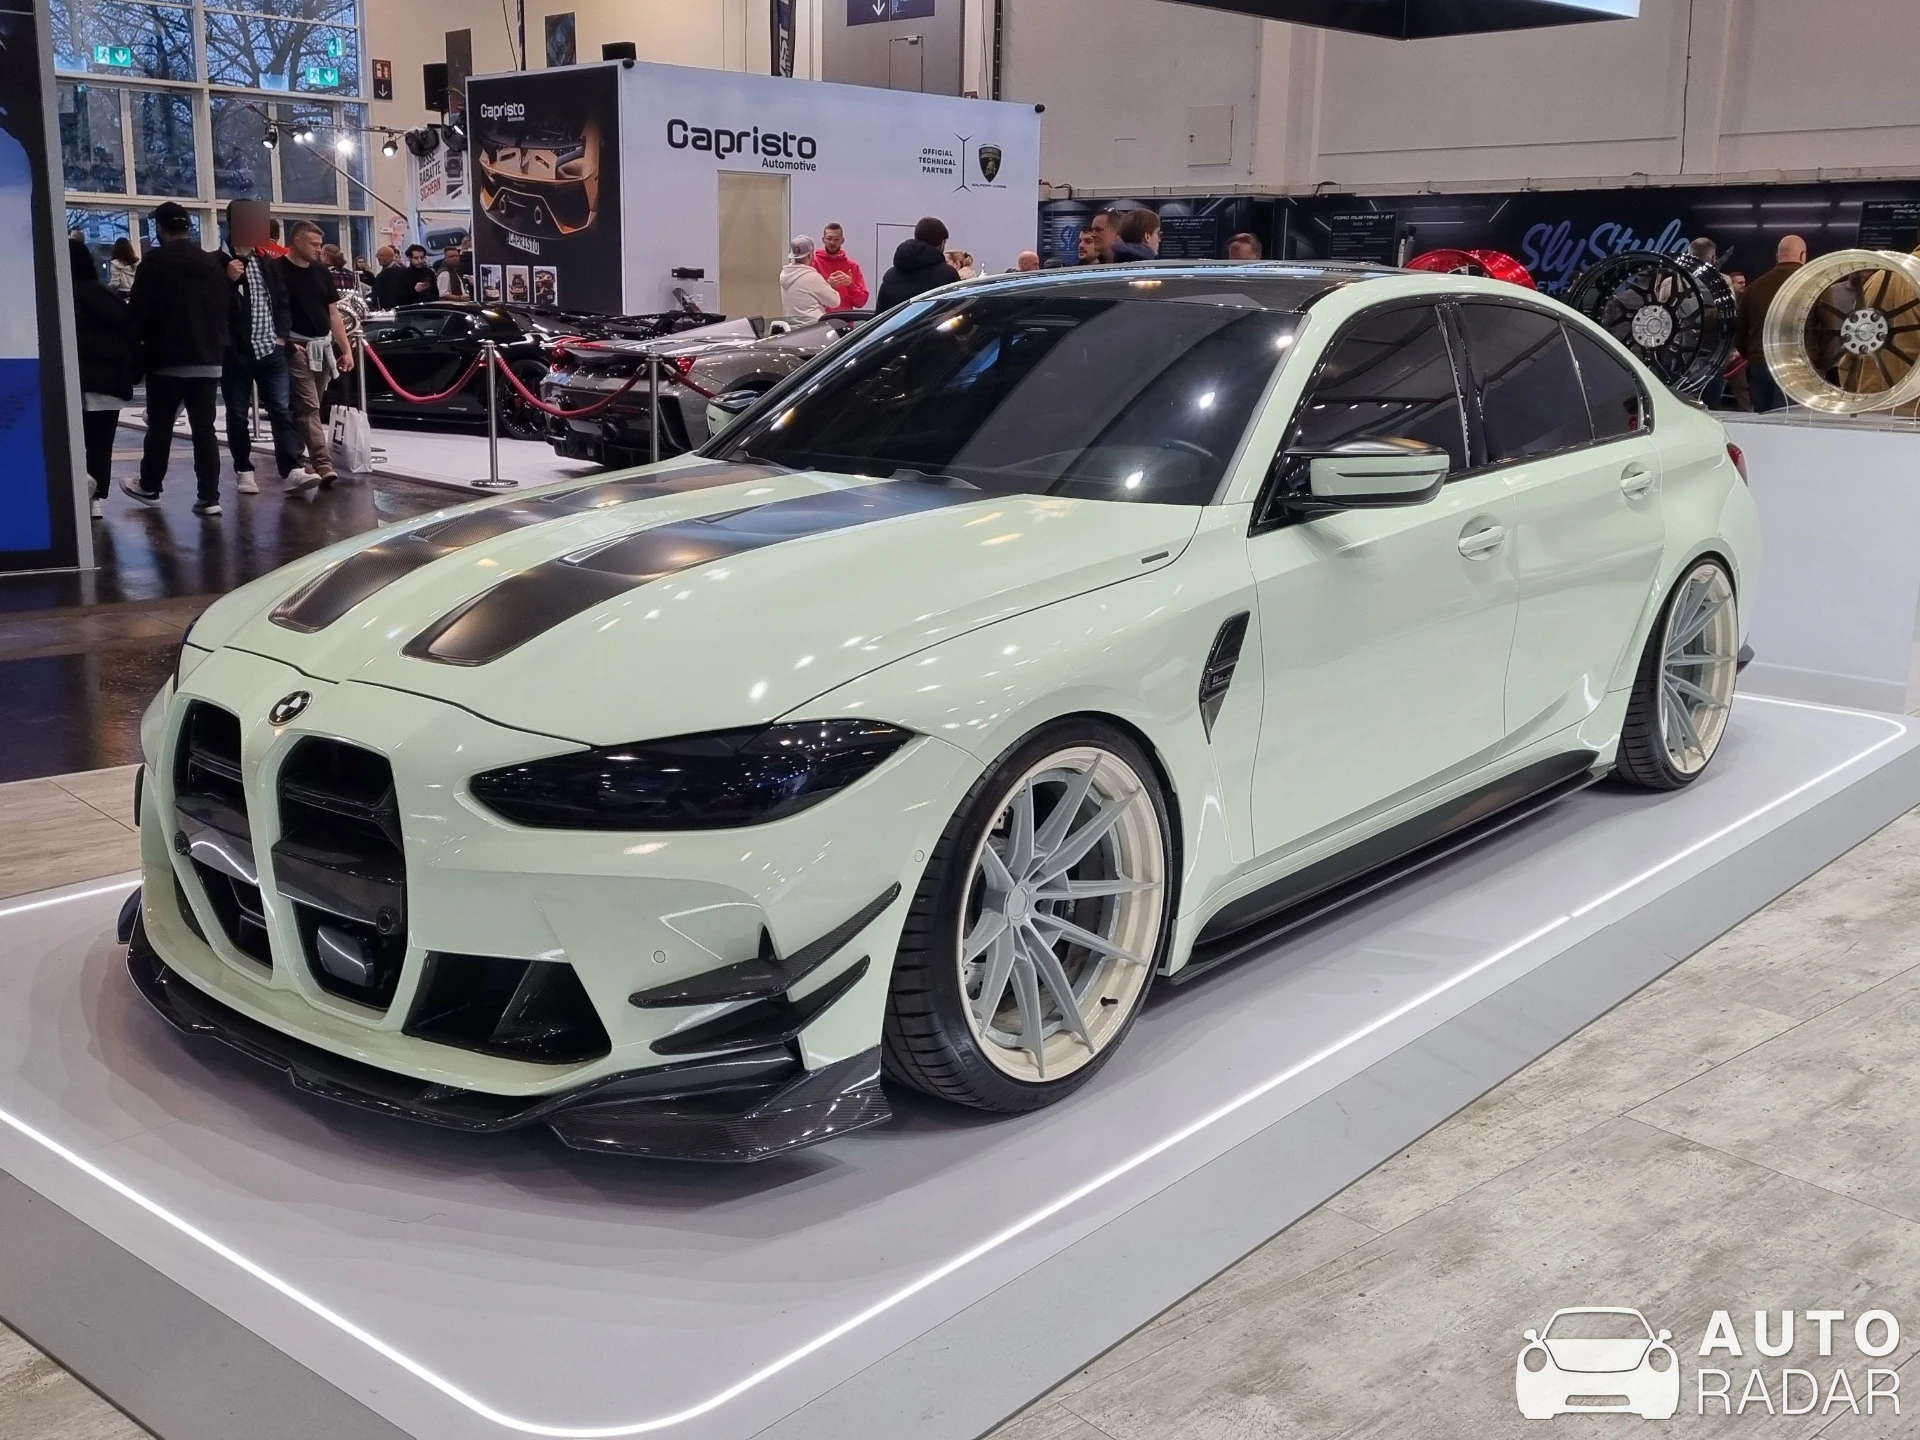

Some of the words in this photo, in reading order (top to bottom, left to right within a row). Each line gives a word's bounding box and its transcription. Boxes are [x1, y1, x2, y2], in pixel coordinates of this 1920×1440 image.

[480, 102, 525, 120] Capristo
[667, 118, 817, 160] Capristo
[922, 148, 953, 157] OFFICIAL
[761, 157, 817, 171] Automotive
[919, 157, 957, 166] TECHNICAL
[922, 166, 953, 175] PARTNER
[509, 233, 539, 253] CAPRISTO
